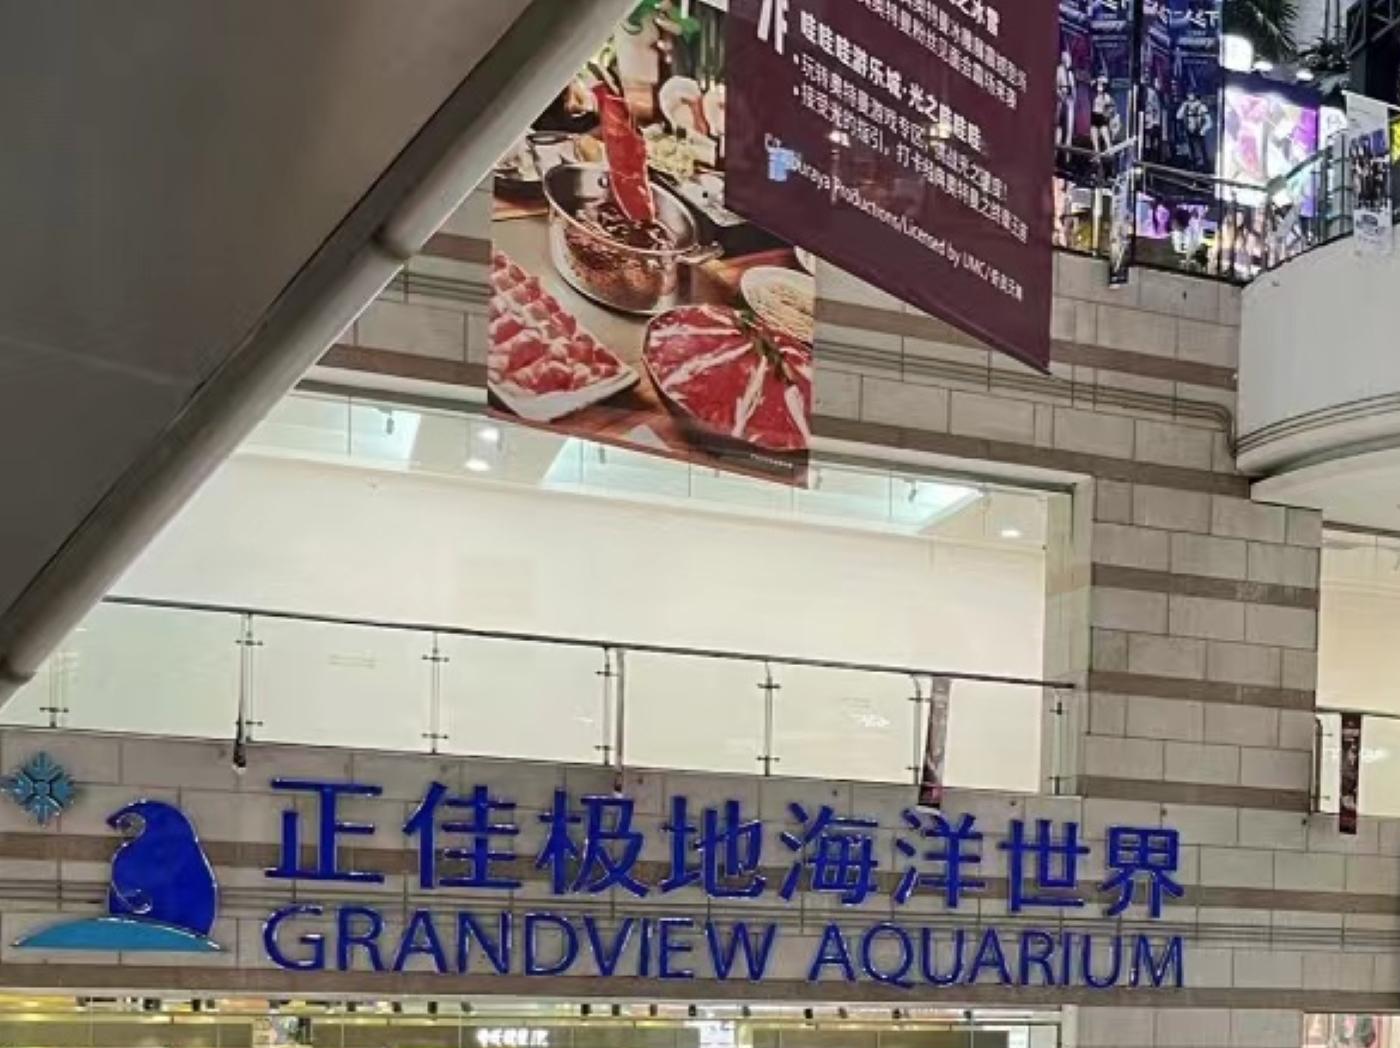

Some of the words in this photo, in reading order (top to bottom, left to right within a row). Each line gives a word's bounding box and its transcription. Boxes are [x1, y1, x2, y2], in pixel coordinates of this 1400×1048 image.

[265, 777, 1185, 918] 正佳极地海洋世界
[263, 904, 777, 983] GRANDVIEW
[808, 921, 1185, 989] AQUARIUM
